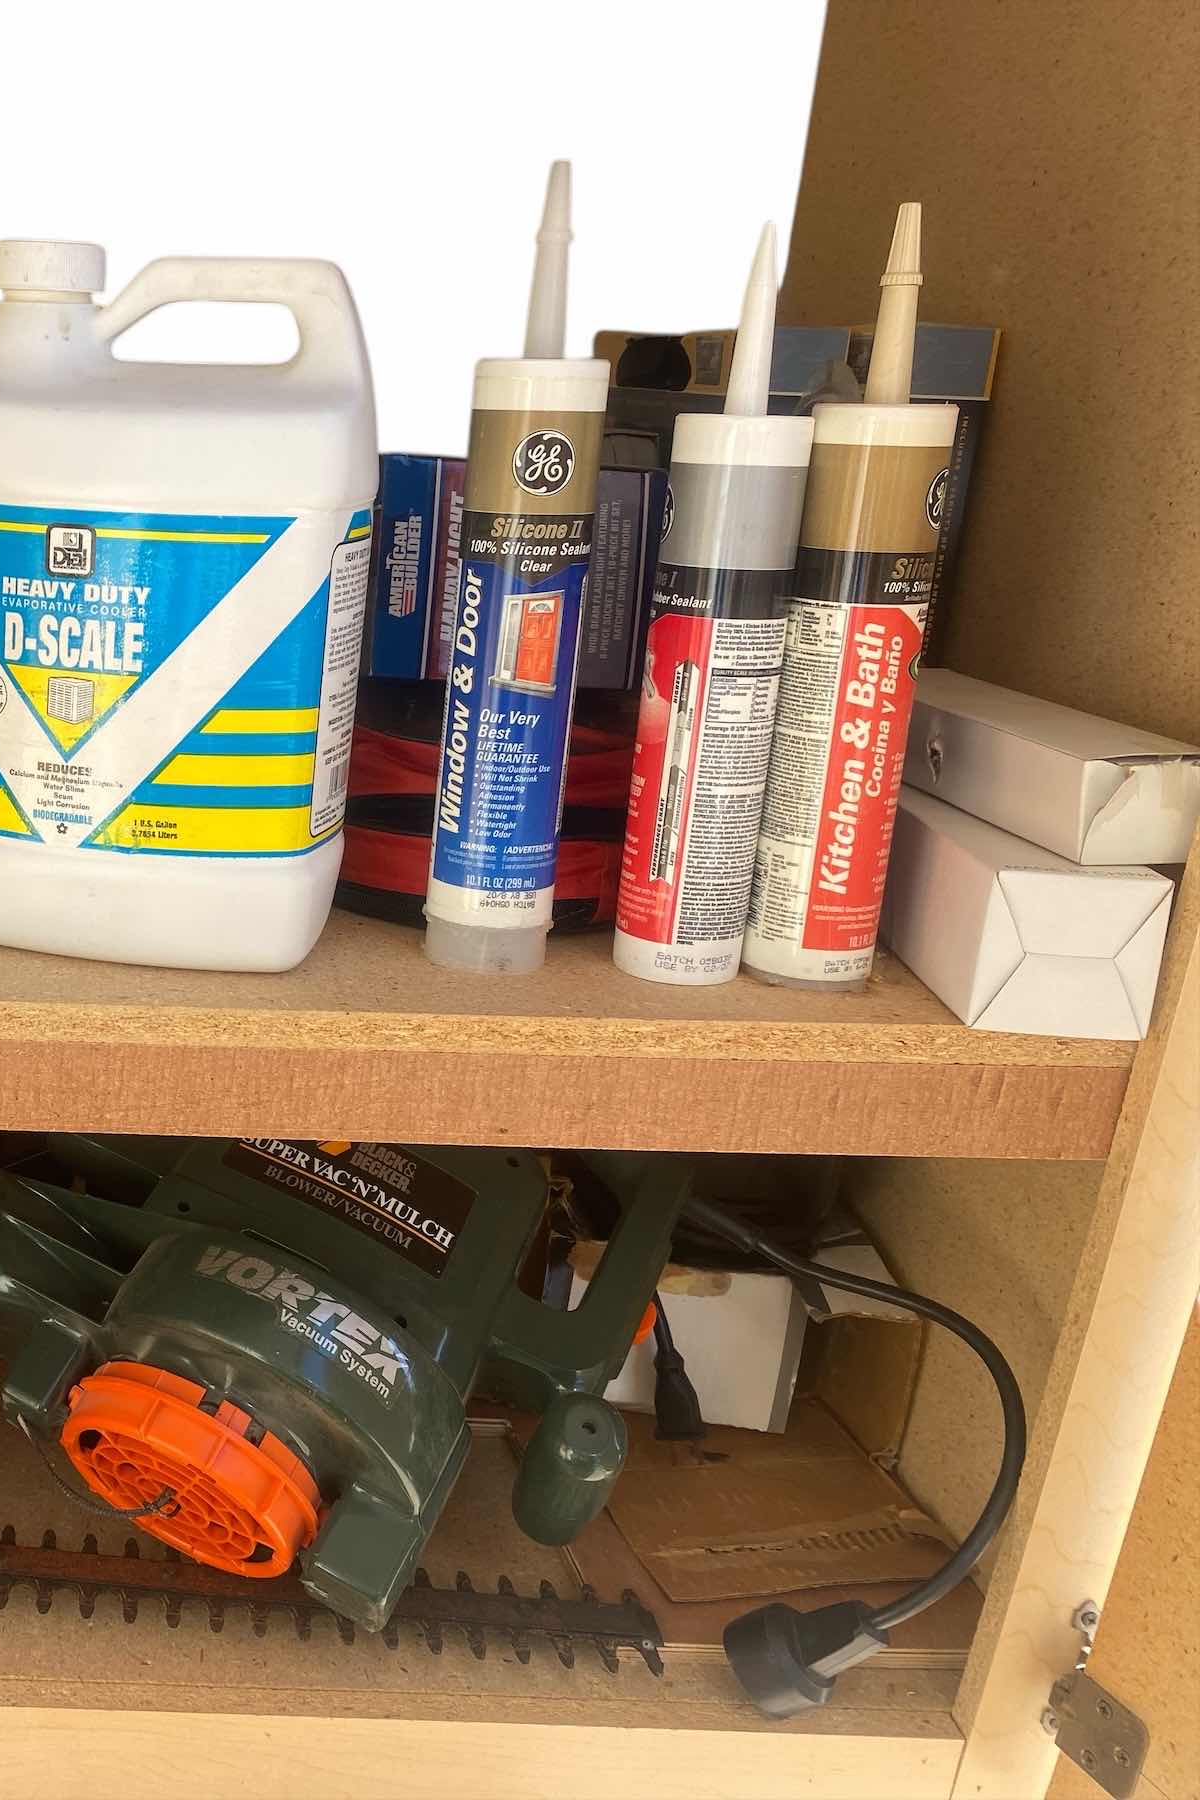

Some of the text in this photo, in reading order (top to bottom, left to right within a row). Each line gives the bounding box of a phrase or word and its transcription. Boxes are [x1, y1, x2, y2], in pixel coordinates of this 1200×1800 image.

[525, 444, 563, 481] GE
[491, 517, 568, 539] Silicone
[404, 515, 422, 591] BUILDER
[471, 540, 558, 556] 100% Silicone
[386, 520, 409, 617] AMERICAN
[520, 560, 552, 572] Clear
[2, 577, 151, 604] HEAVY DUTY
[884, 582, 910, 592] 100%
[2, 597, 145, 618] EVAPORATIVE COOLER
[671, 594, 712, 609] Sealant
[456, 568, 482, 656] Door
[4, 611, 144, 672] D-SCALE
[847, 622, 887, 708] Bath
[883, 635, 904, 695] Baño
[454, 664, 474, 694] &
[881, 702, 897, 716] y
[480, 709, 540, 728] Our Very
[478, 725, 511, 739] Best
[839, 721, 871, 750] &
[477, 741, 524, 752] LIFETIME
[477, 752, 539, 764] GUARANTEE
[865, 721, 891, 799] Cocina
[10, 769, 35, 779] Calcium
[37, 761, 93, 776] REDUCES
[440, 700, 469, 833] Window
[481, 765, 538, 773] Indoor/Outdoor
[498, 774, 512, 782] Not
[43, 782, 84, 793] Water Slime
[480, 783, 525, 793] Outstanding
[37, 799, 53, 807] Light
[54, 792, 73, 800] Scum
[478, 792, 514, 801] Adhesion
[478, 801, 525, 812] Permanently
[33, 809, 93, 825] BIODEGRADABLE
[477, 810, 507, 819] Flexible
[476, 820, 516, 830] Watertight
[818, 759, 864, 894] Kitchen
[475, 829, 512, 838] Low Odor
[460, 842, 496, 853] WARNING:
[466, 875, 535, 890] 10.1 FL OZ (299 mL)
[264, 1164, 412, 1249] BLOWER/VACUUM
[195, 1246, 409, 1386] VORTEX
[280, 1309, 389, 1398] Vacuum System
